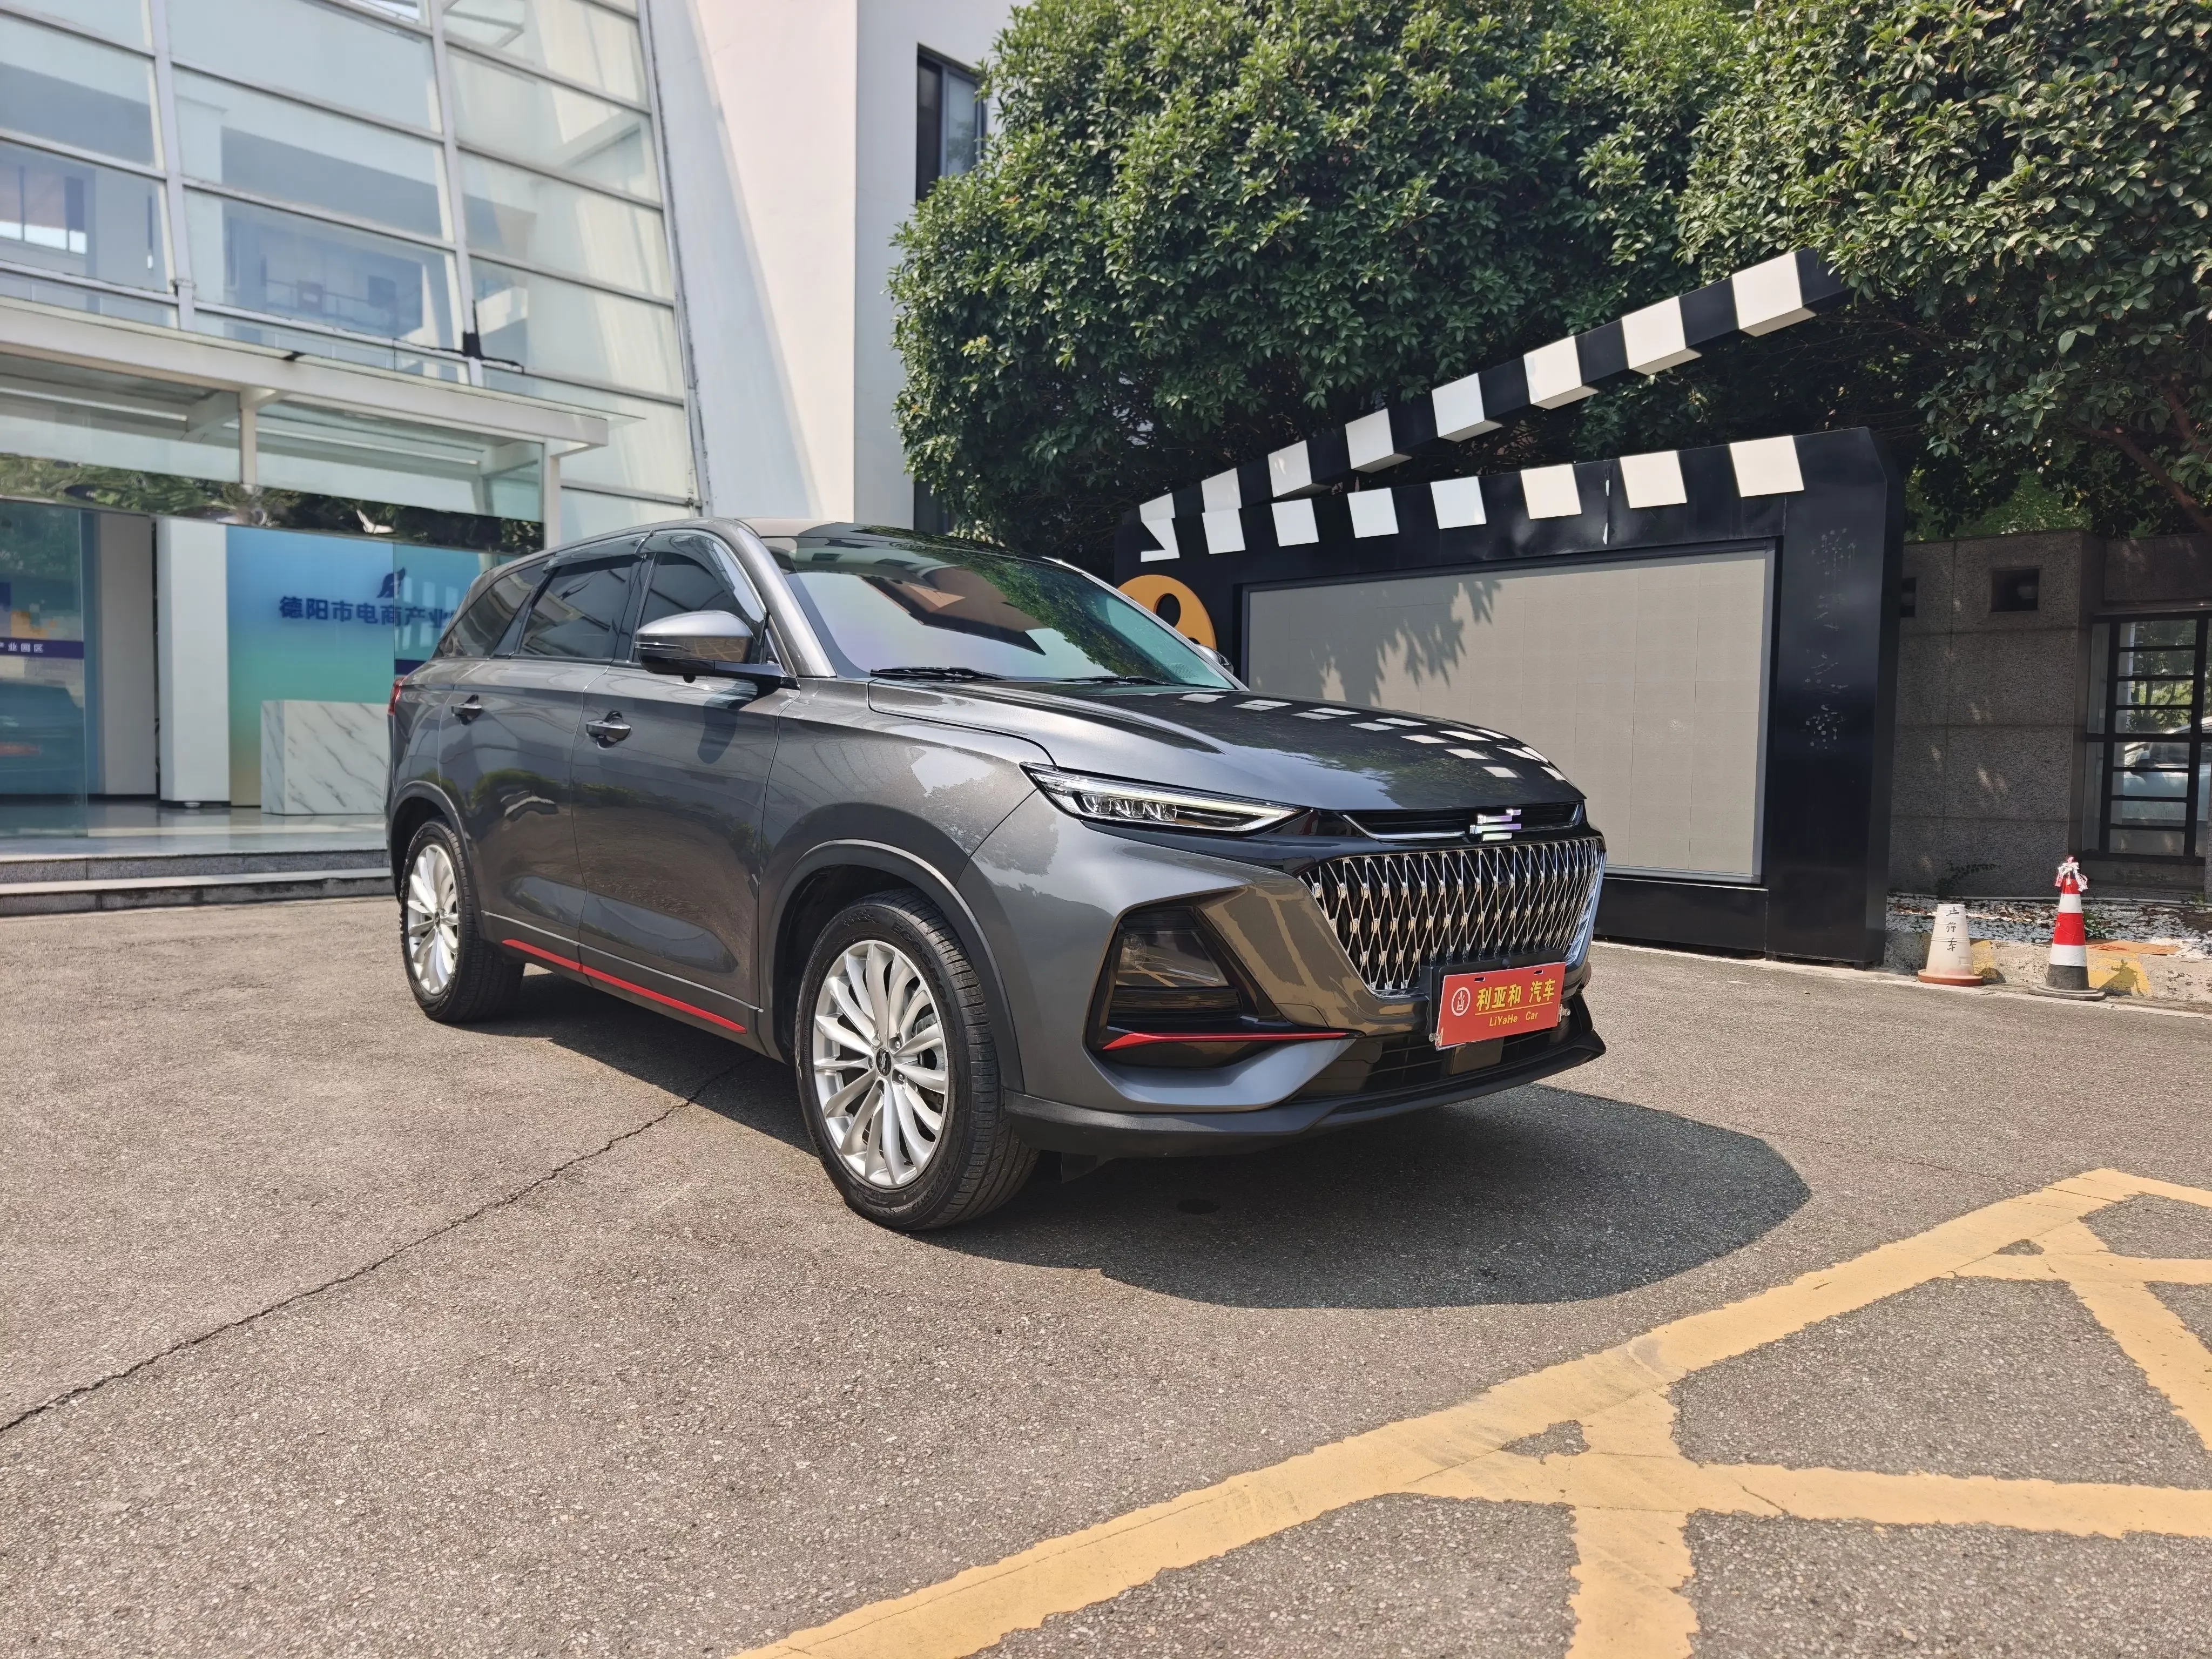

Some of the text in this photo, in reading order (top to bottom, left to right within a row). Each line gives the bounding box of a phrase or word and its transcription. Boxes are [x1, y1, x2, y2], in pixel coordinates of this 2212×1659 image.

[279, 596, 454, 628] 德阳市电商产业
[1476, 978, 1556, 1011] 利亚和 汽车
[1489, 1011, 1538, 1027] LiYaHe Car
